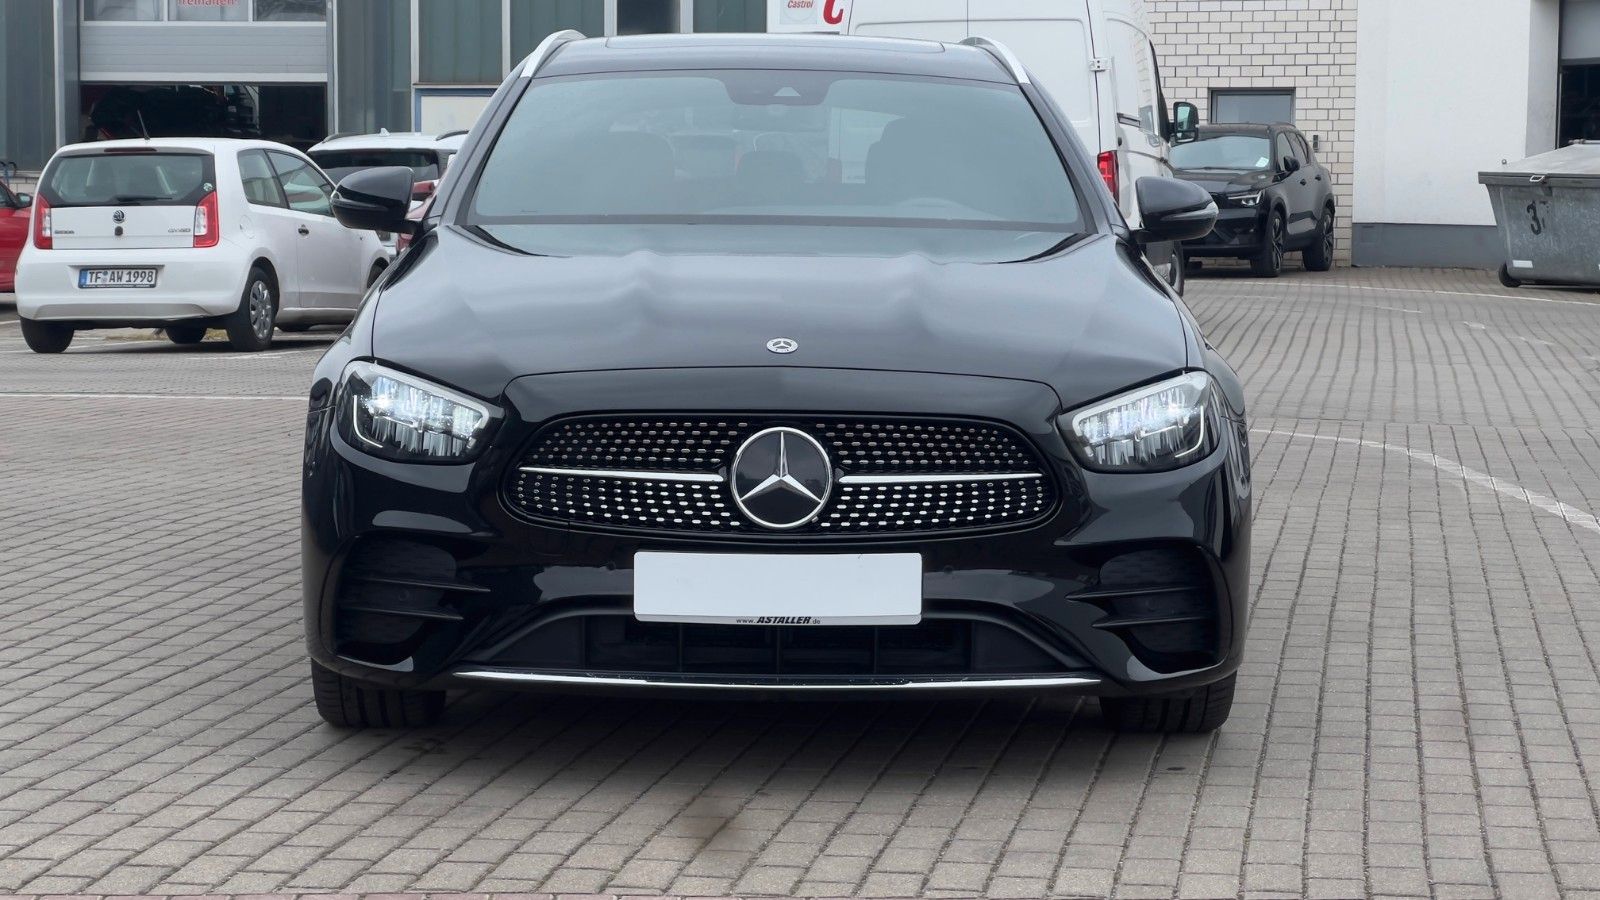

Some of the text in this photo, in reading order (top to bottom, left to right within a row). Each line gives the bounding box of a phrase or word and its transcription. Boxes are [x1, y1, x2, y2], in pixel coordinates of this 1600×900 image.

[787, 0, 813, 8] Castrol
[89, 271, 154, 283] TF AW 1998
